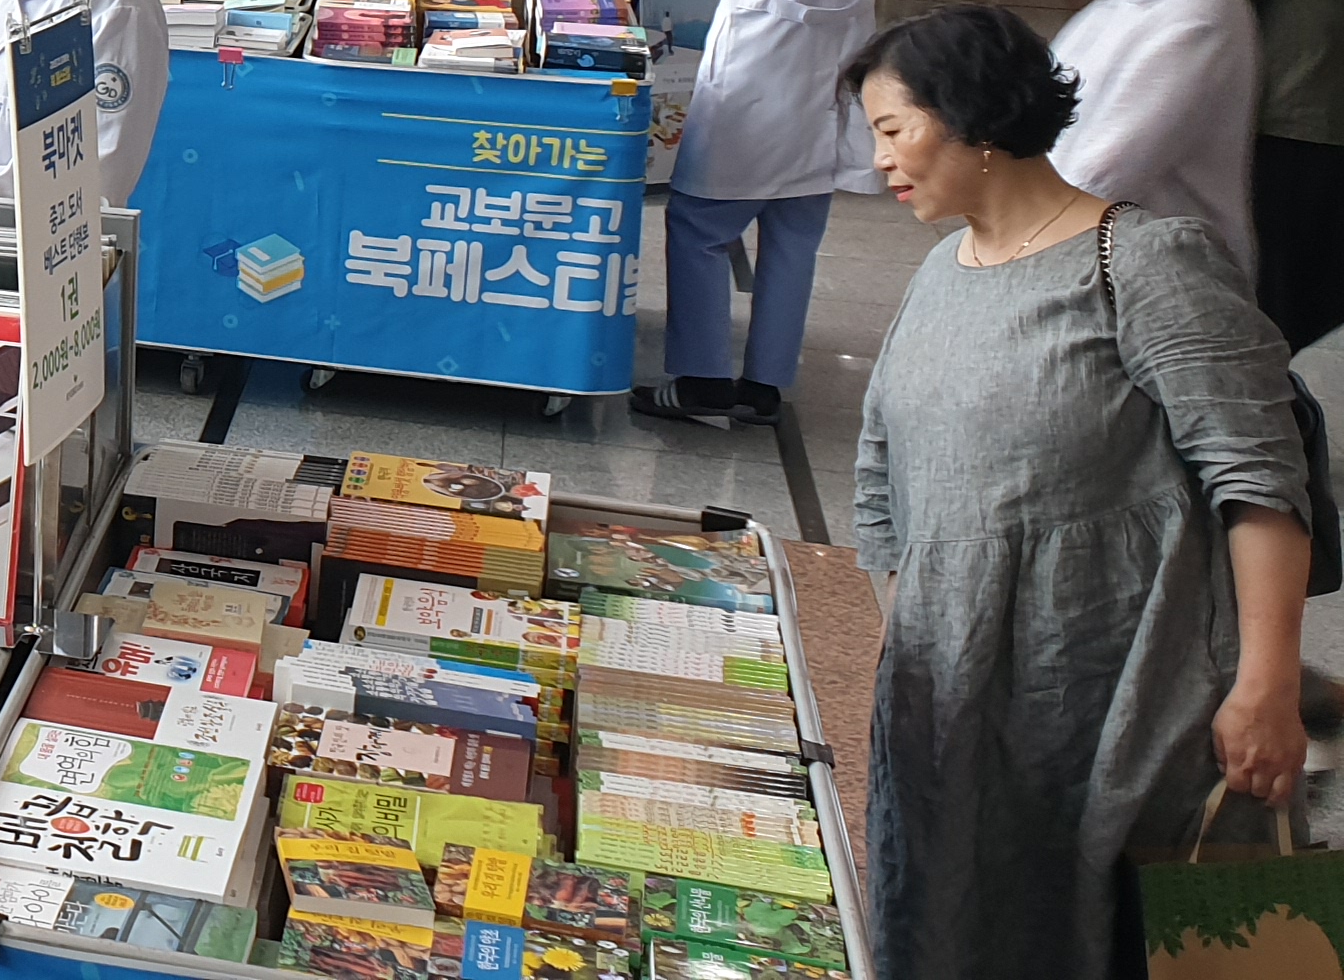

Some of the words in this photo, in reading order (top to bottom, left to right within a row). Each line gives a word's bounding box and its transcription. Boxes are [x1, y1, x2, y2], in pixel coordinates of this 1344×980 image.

[40, 109, 85, 181] 북마켓
[471, 129, 609, 171] 찾아가는
[49, 198, 66, 235] 중고
[67, 186, 84, 221] 도서
[420, 184, 624, 244] 교보문고
[43, 238, 68, 276] 베스트
[68, 220, 90, 260] 단행본
[60, 271, 81, 322] 1권
